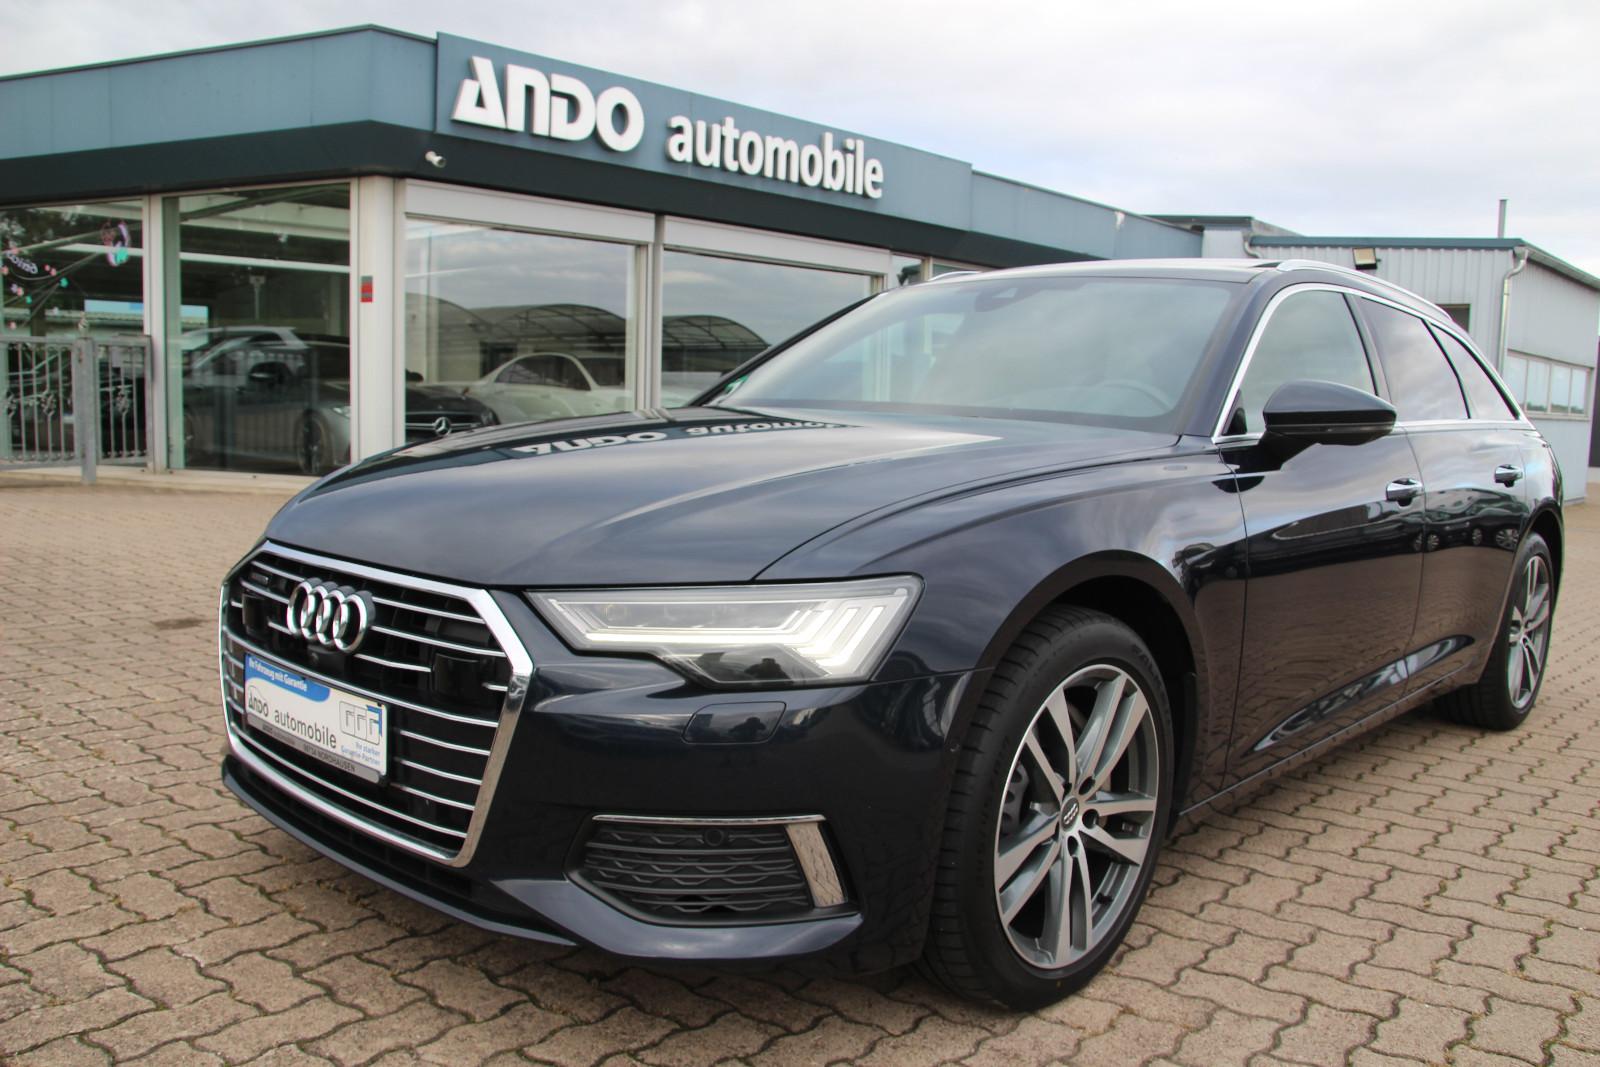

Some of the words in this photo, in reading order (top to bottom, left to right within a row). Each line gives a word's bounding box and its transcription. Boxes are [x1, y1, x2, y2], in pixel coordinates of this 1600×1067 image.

[451, 56, 645, 152] ANDO
[666, 115, 885, 200] automobile
[274, 708, 338, 749] automobile
